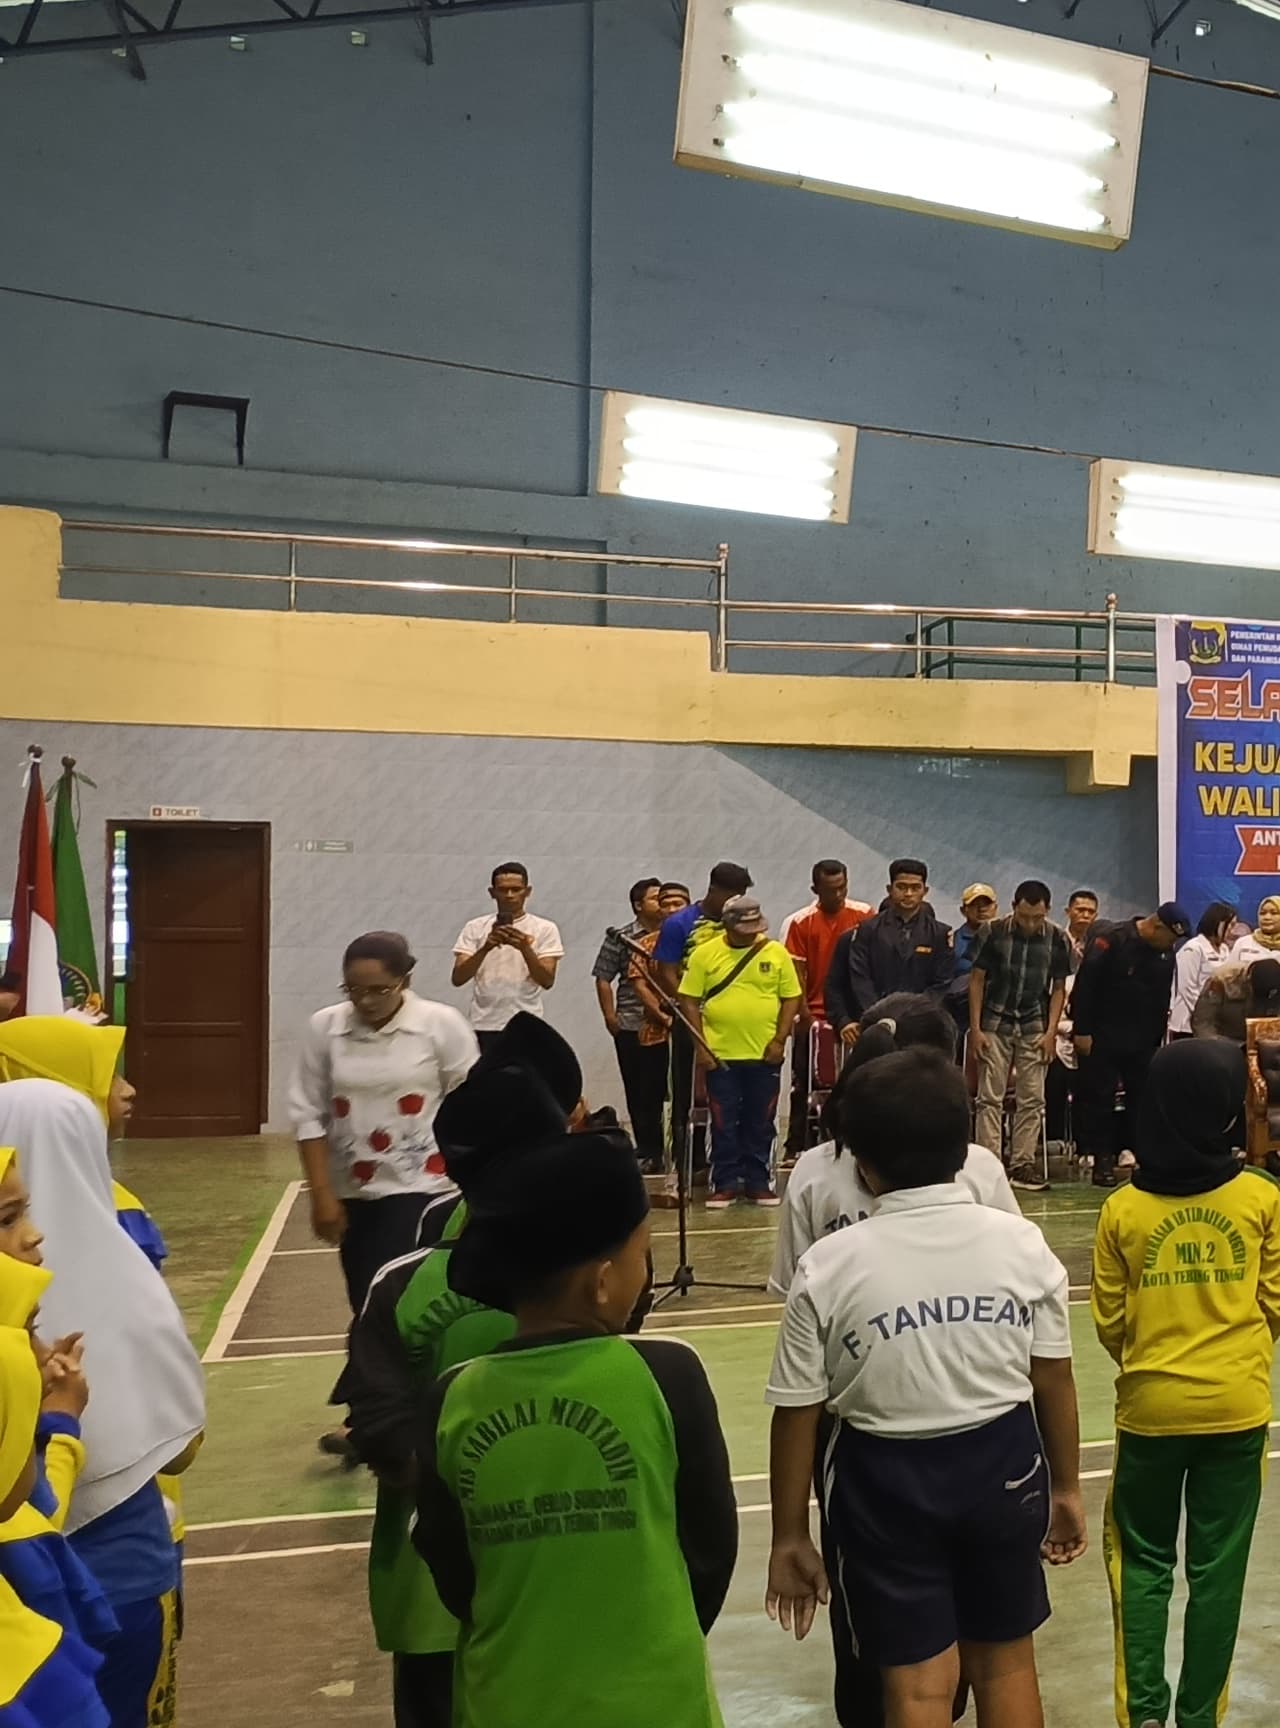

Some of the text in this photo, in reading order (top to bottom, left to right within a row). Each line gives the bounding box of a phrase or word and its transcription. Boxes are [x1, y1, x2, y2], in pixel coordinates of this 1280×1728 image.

[165, 807, 198, 817] TOILET
[1197, 784, 1280, 818] WALI
[1142, 1271, 1171, 1288] KOTA
[1173, 1268, 1210, 1285] TEBING
[841, 1329, 872, 1361] F.
[462, 1397, 538, 1464] SABILAL
